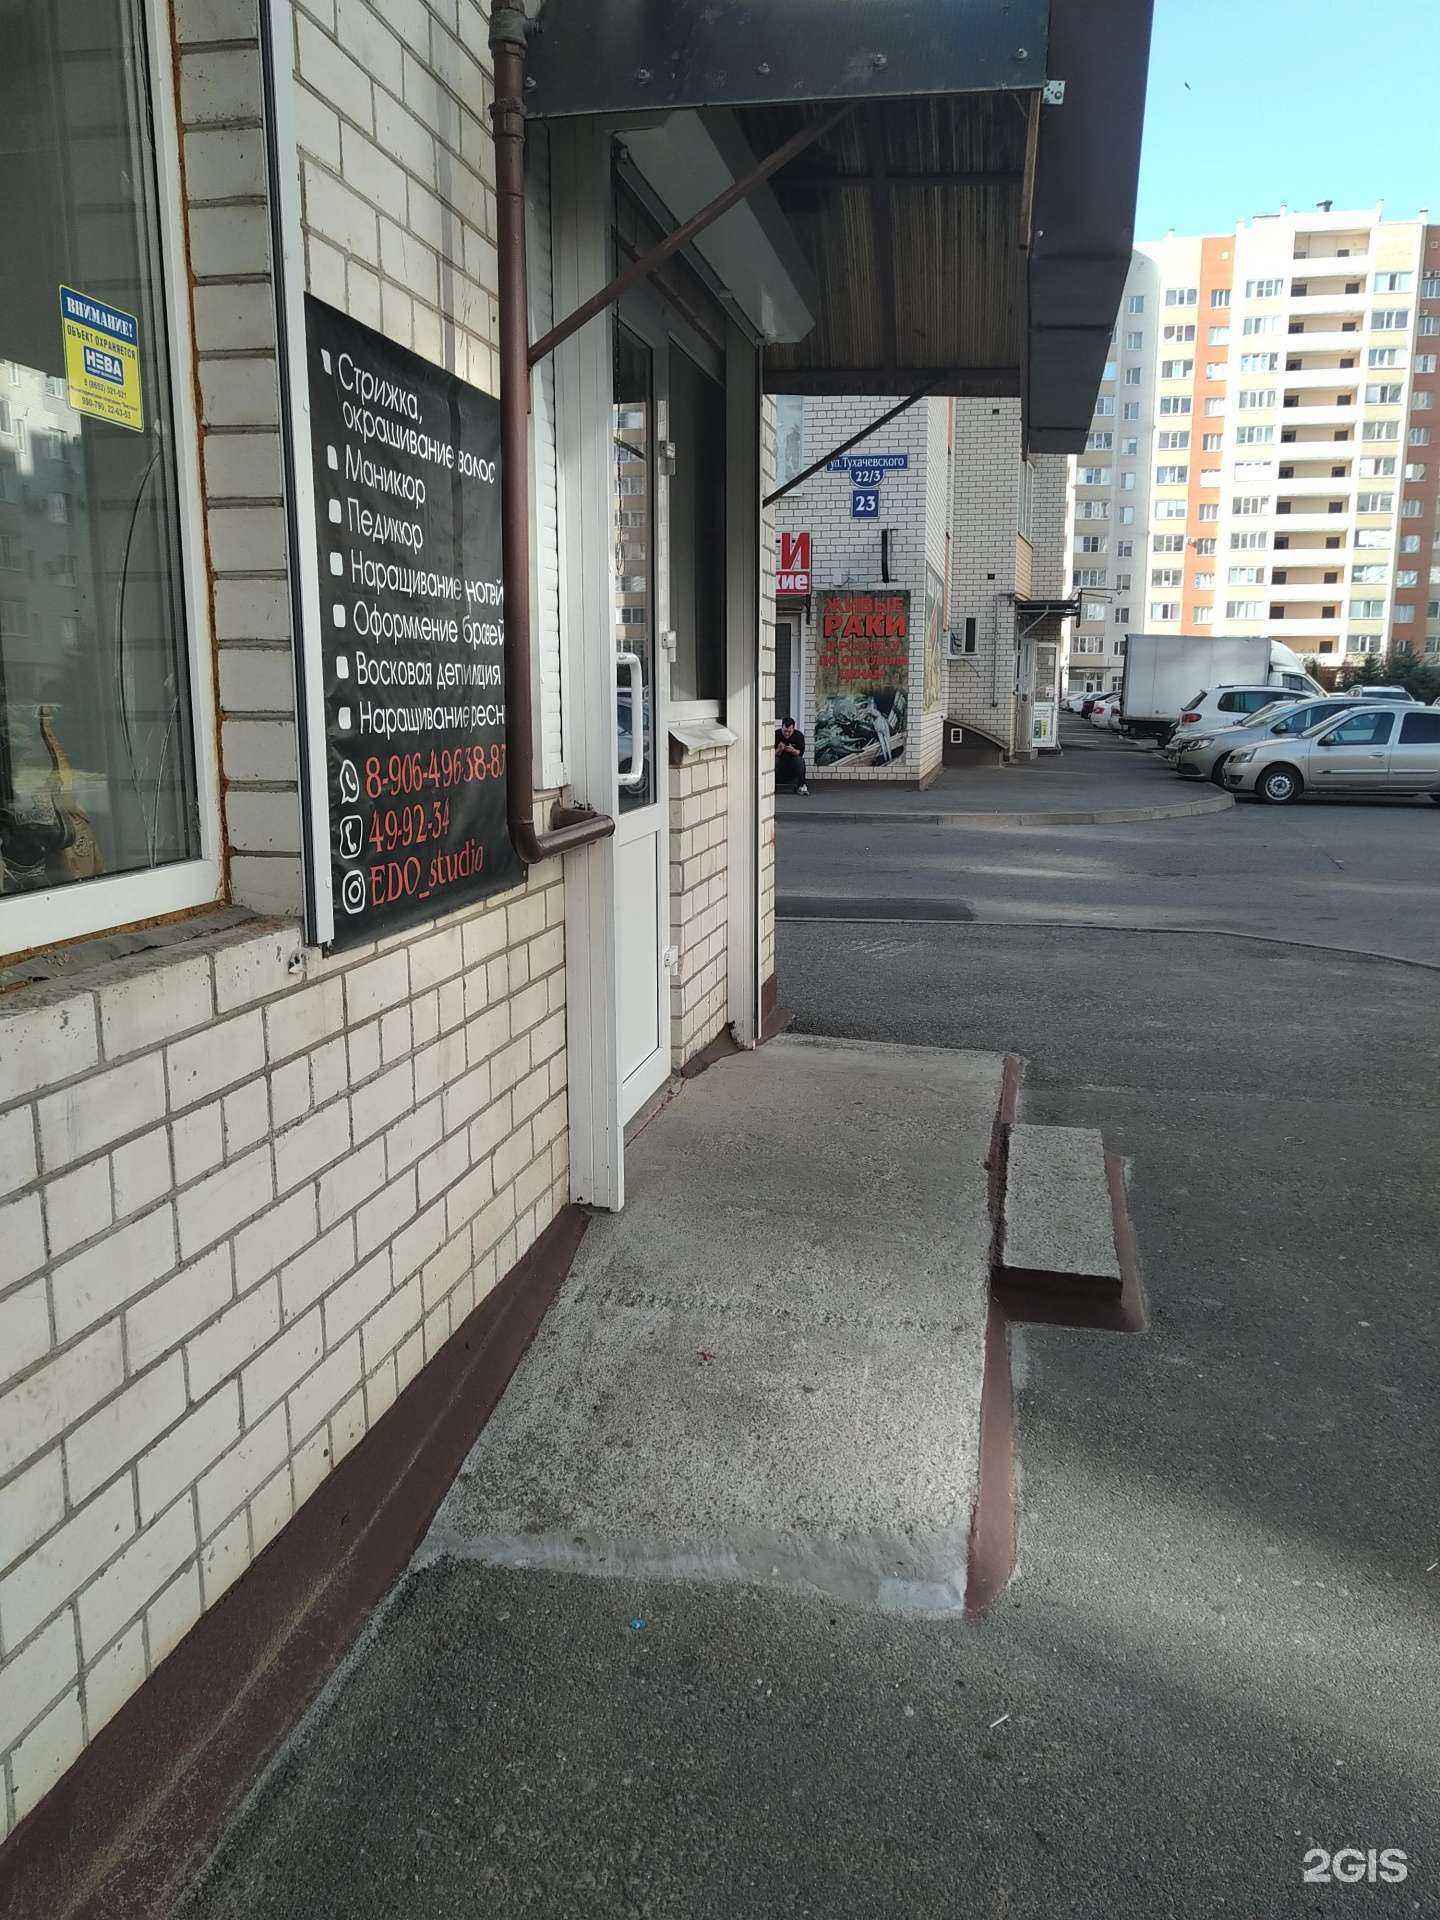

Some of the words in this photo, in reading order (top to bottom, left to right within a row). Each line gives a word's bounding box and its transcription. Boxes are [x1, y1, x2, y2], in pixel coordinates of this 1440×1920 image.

[67, 296, 133, 338] ВНИМАНИЕ!
[67, 324, 93, 343] ОБЪЕКТ
[86, 348, 122, 377] НЕВА
[338, 353, 423, 424] Стрижка,
[342, 401, 454, 469] окрашивание
[458, 450, 495, 484] волос
[345, 444, 426, 509] Маникюр
[855, 470, 880, 483] 22/3
[855, 495, 876, 511] 23
[347, 497, 424, 555] Педикюр
[351, 549, 462, 601] Наращивание
[353, 601, 458, 645] Оформление
[825, 595, 904, 613] ЖИВЫЕ
[823, 615, 907, 638] РАКИ
[356, 651, 432, 686] Восковая
[436, 662, 501, 691] депиляция
[359, 701, 470, 740] Наращивание
[470, 704, 506, 734] ресн
[370, 838, 484, 906] EDO_studio
